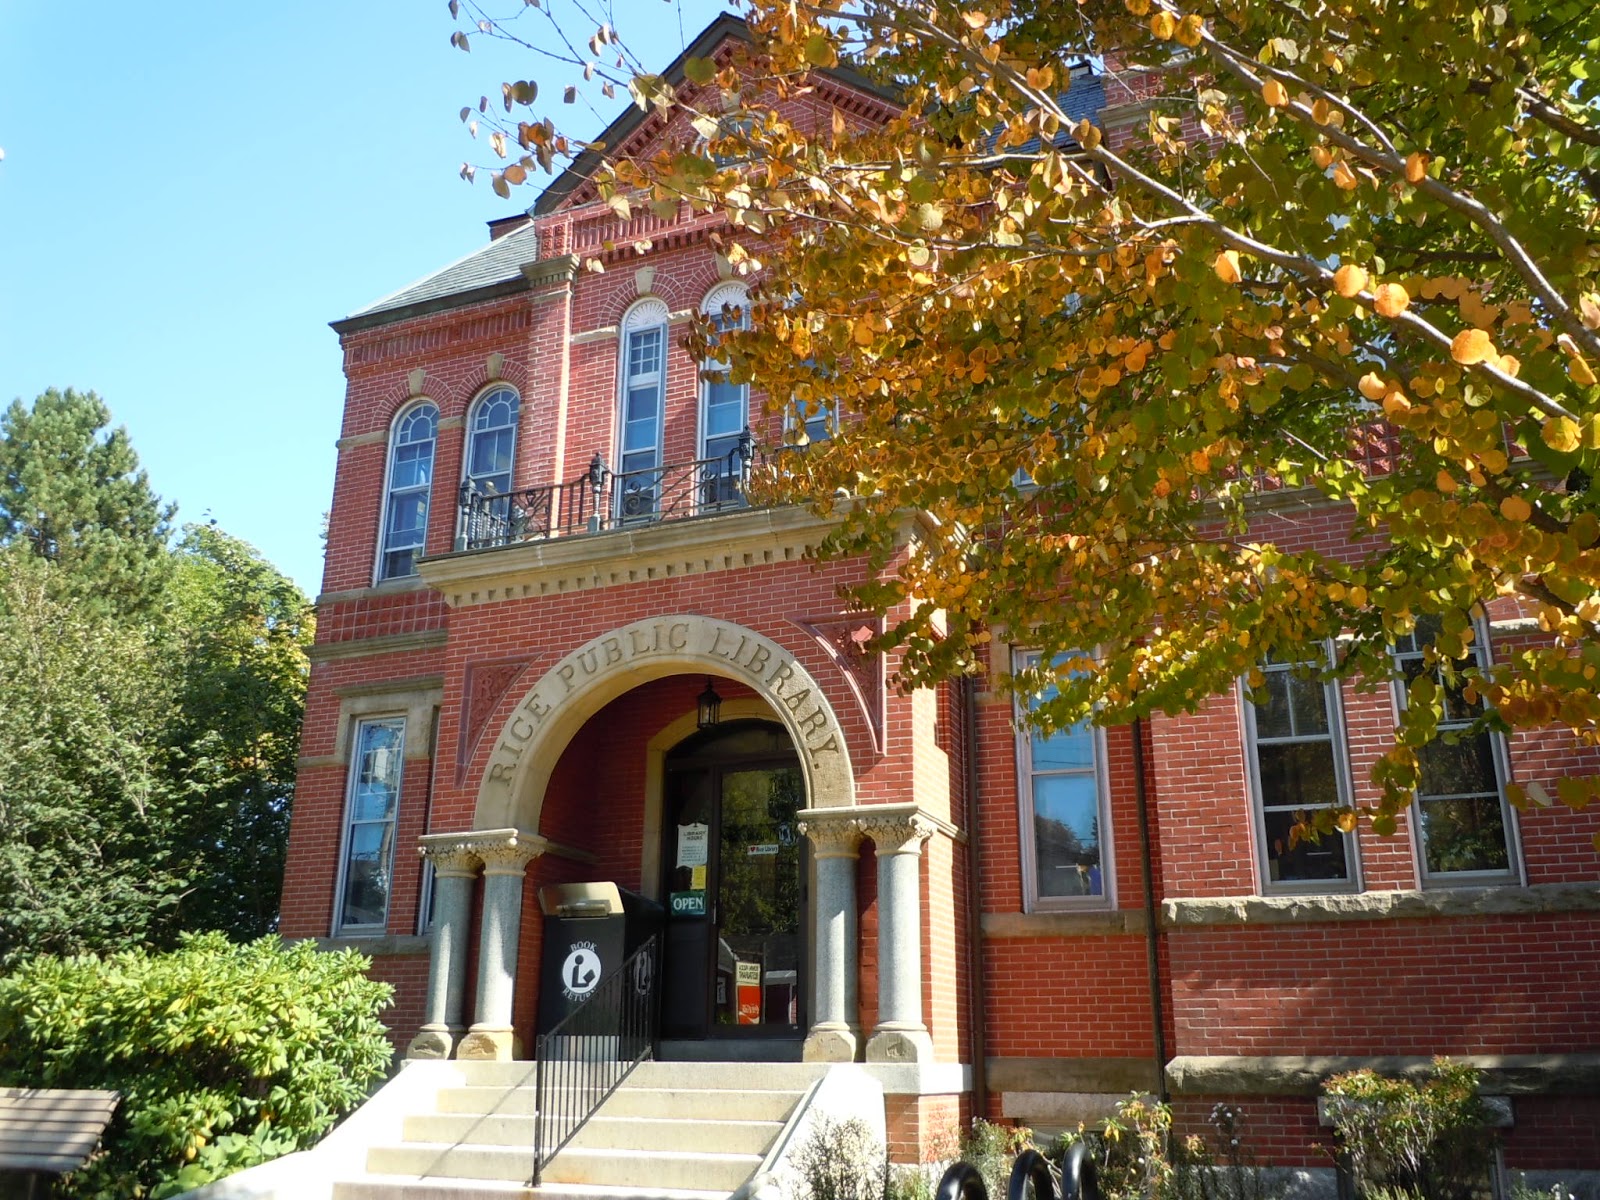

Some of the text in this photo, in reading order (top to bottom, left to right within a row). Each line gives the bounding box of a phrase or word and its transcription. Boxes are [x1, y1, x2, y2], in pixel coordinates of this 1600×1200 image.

[488, 692, 552, 788] RICE
[555, 622, 690, 694] PUBLIC
[673, 896, 704, 911] OPEN
[570, 940, 598, 952] BOOK
